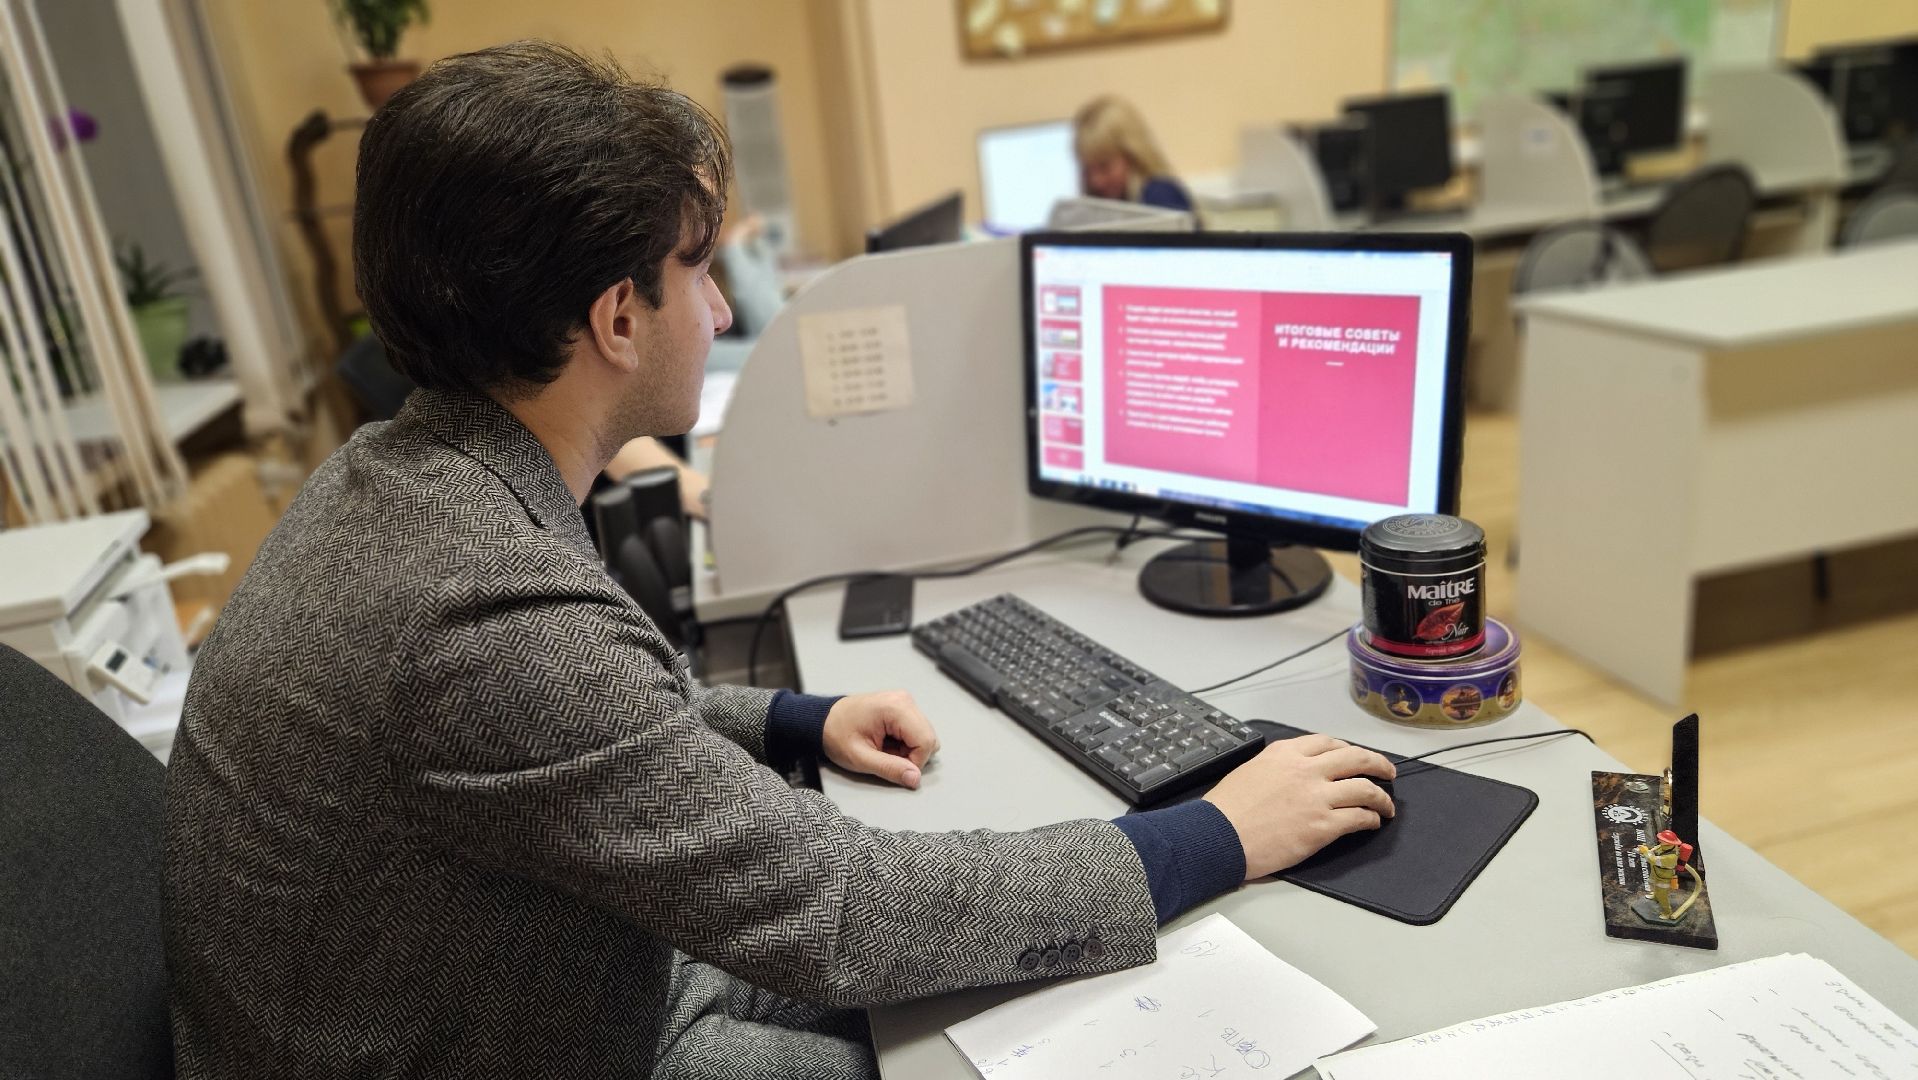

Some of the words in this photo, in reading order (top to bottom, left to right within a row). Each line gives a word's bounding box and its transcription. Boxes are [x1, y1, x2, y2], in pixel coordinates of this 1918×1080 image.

[1274, 324, 1342, 338] ИТОГОВЫЕ
[1345, 328, 1400, 341] СОВЕТЫ
[1278, 338, 1288, 348] И
[1291, 338, 1396, 355] РЕКОМЕНДАЦИИ
